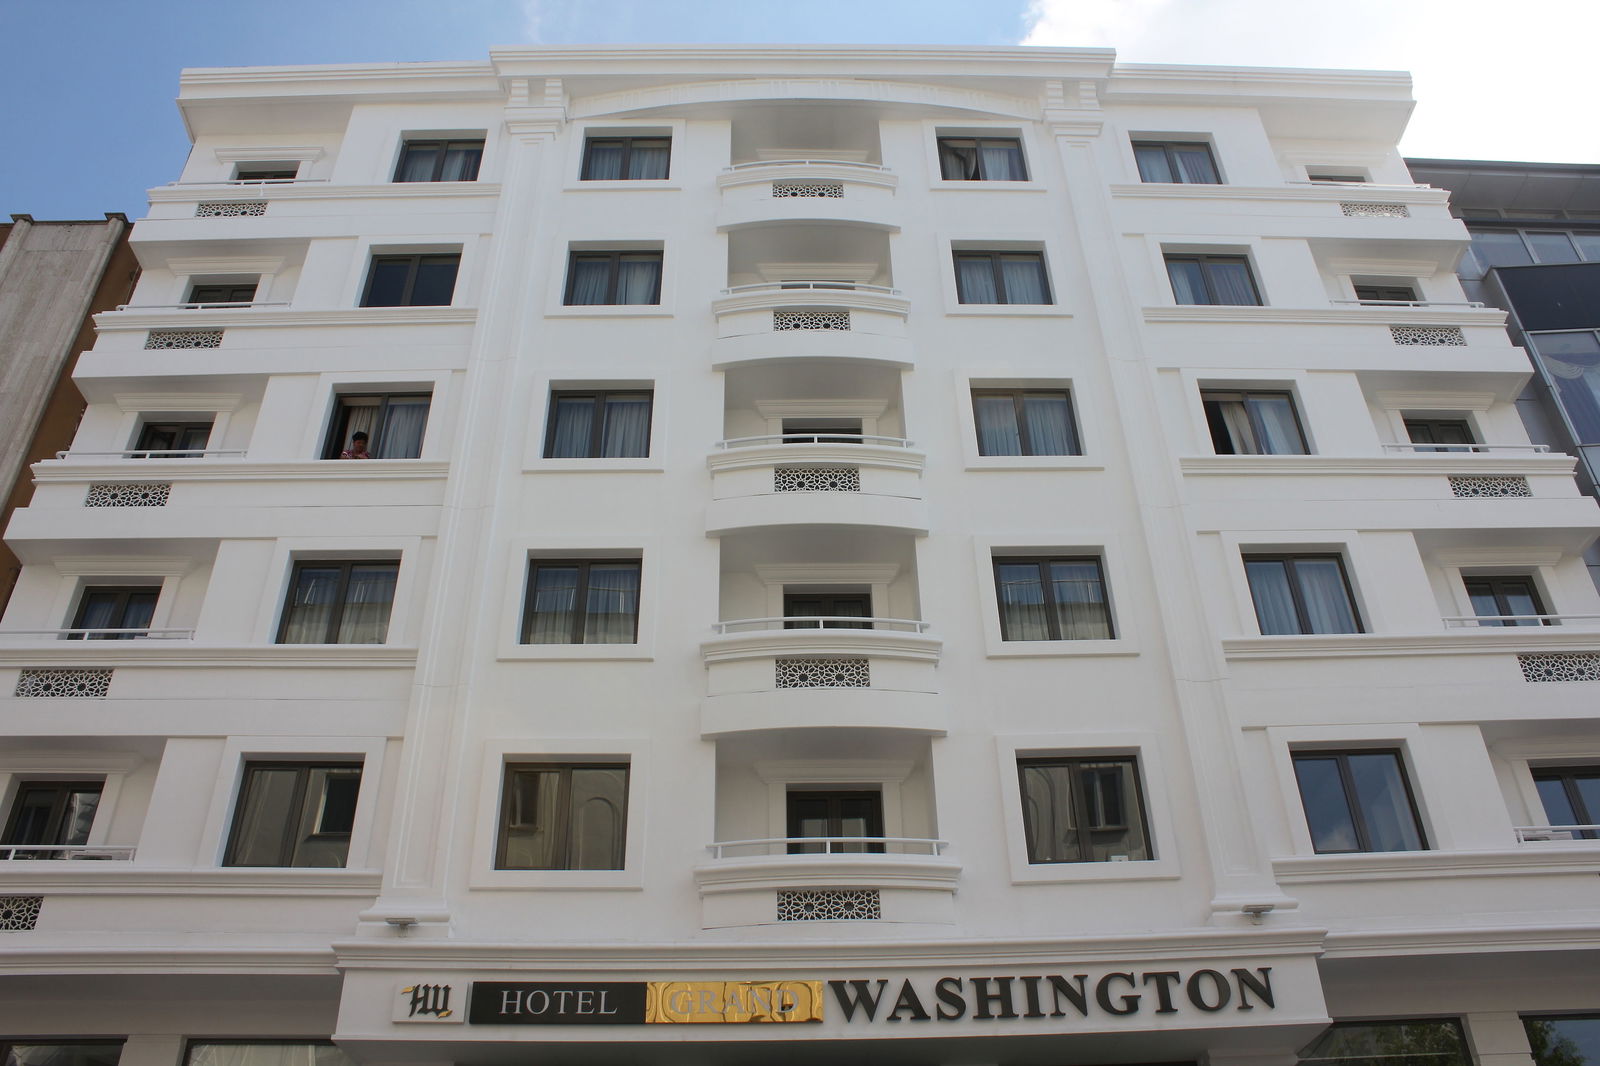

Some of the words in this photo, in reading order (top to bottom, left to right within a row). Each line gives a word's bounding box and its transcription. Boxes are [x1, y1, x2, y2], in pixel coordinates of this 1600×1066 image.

[500, 989, 618, 1015] HOTEL
[670, 988, 801, 1015] GRAND
[827, 967, 1276, 1023] WASHINGTON
